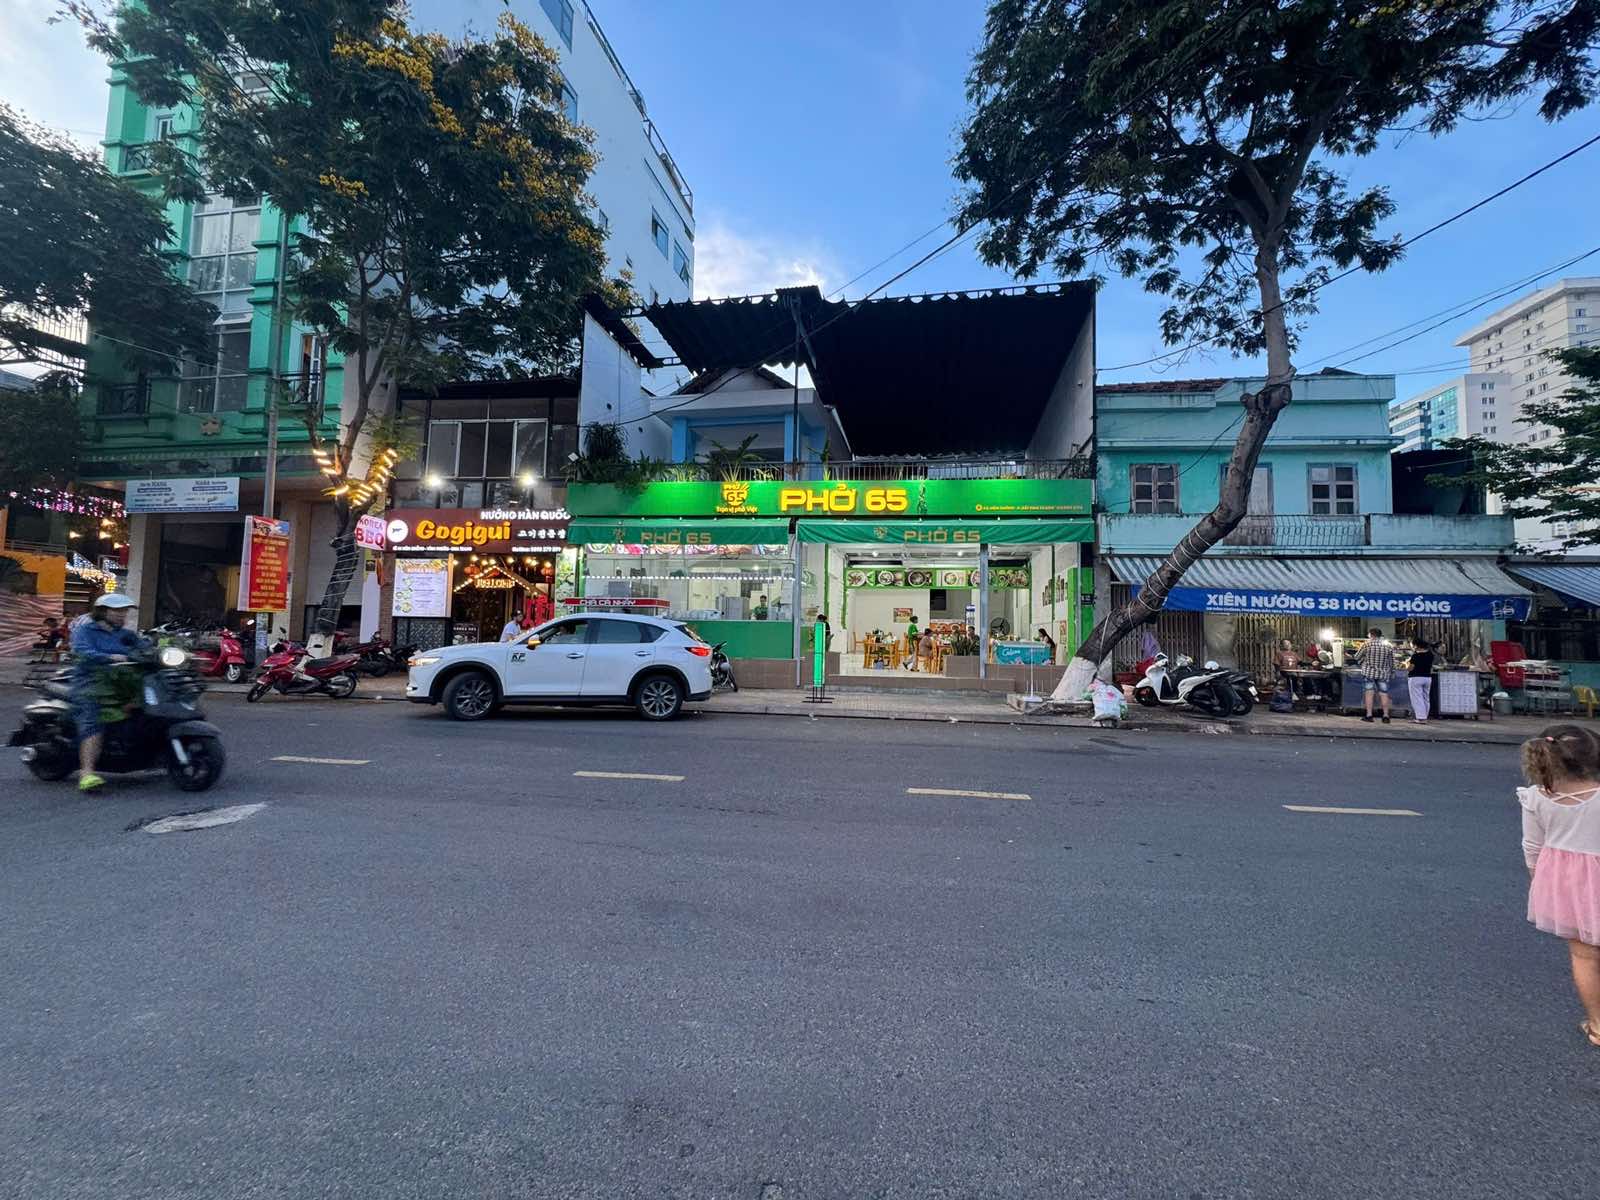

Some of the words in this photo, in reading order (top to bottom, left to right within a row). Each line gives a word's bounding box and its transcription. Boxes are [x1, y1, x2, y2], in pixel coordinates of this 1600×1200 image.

[726, 491, 746, 503] 65
[780, 484, 857, 512] PHỞ
[865, 489, 908, 512] 65
[480, 508, 517, 520] NƯỚNG
[518, 508, 540, 520] HÀN
[355, 527, 385, 549] BBQ
[416, 520, 512, 545] Gogigui
[641, 529, 682, 544] PHỞ
[687, 532, 712, 544] 65
[904, 527, 948, 542] PHỞ
[953, 530, 980, 542] 65
[1206, 592, 1247, 607] XIÊN
[1251, 593, 1315, 609] NƯỚNG
[1318, 598, 1340, 610] 38
[1344, 596, 1382, 611] HÒN
[1386, 595, 1450, 613] CHỒNG
